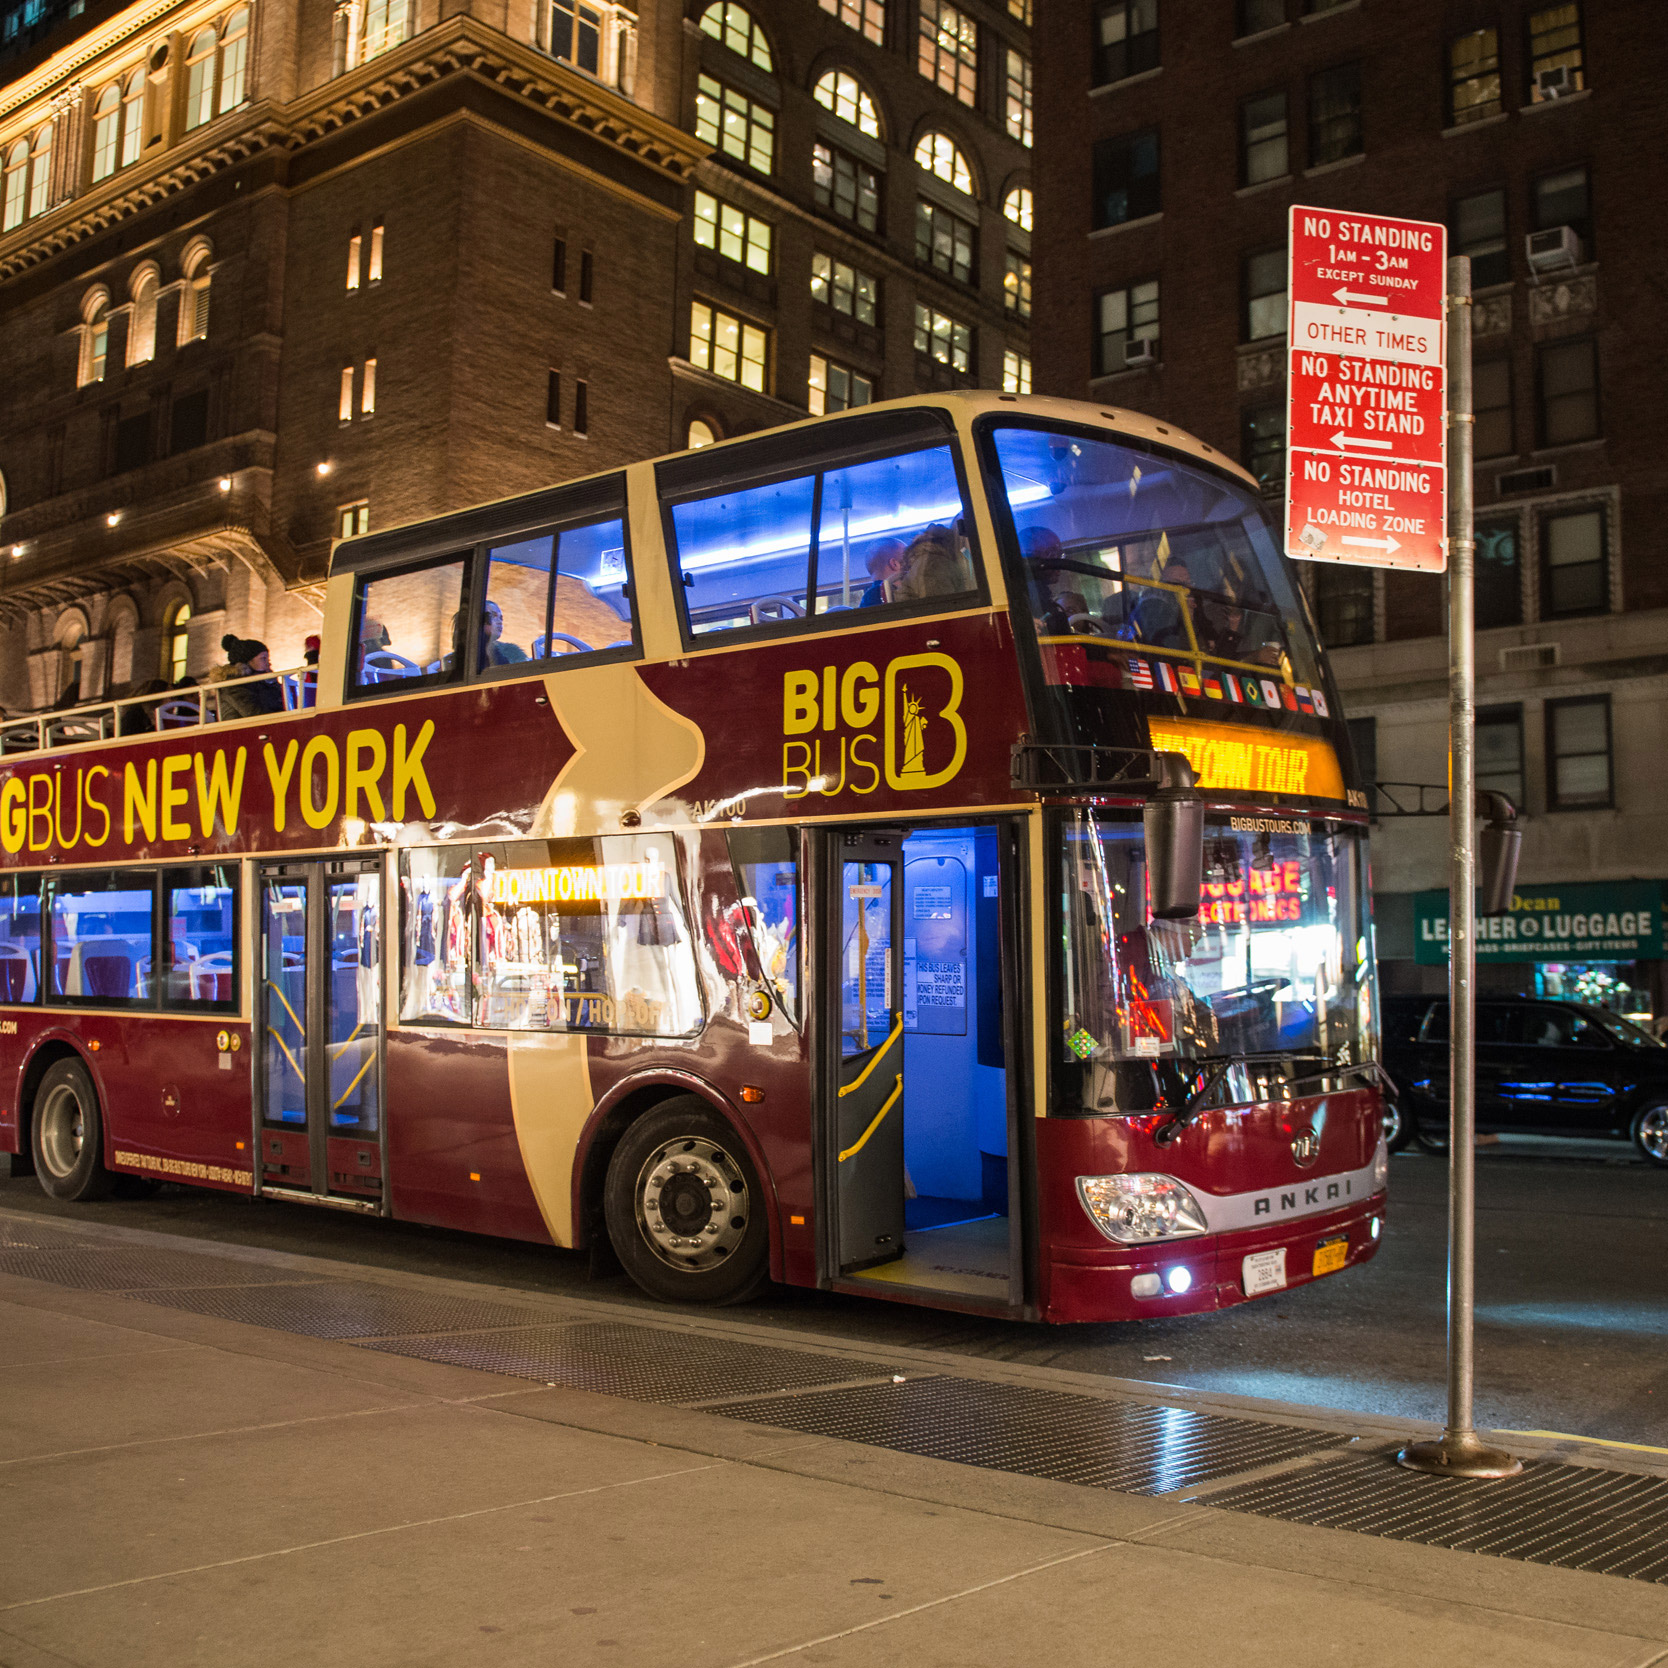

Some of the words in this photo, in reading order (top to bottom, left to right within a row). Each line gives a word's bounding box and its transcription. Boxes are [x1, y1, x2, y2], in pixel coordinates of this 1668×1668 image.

[1304, 216, 1331, 238] NO
[1338, 221, 1433, 252] STANDING
[1328, 244, 1357, 265] 1AM
[1374, 251, 1409, 271] 3AM
[1317, 267, 1365, 284] EXCEPT
[1368, 273, 1419, 291] SUNDAY
[1307, 322, 1367, 345] OTHER
[1376, 330, 1428, 353] TIMES
[1301, 356, 1328, 378] NO
[1338, 360, 1434, 391] STANDING
[1318, 382, 1418, 413] ANYTIME
[1310, 404, 1354, 428] TAXI
[1363, 410, 1425, 436] STAND
[1304, 460, 1331, 483] NO
[1339, 464, 1431, 495] STANDING
[1338, 490, 1395, 511] HOTEL
[1307, 506, 1377, 530] LOADING
[1382, 515, 1426, 535] ZONE
[783, 661, 880, 735] BIG
[783, 734, 880, 799] BUS
[1255, 744, 1309, 794] TOUR
[123, 746, 248, 846] NEW
[263, 719, 437, 834] YORK
[1230, 816, 1312, 836] BIGBUSTOURS.COM
[493, 866, 602, 902] DOWNTOWN
[606, 862, 662, 899] TOUR
[1508, 895, 1561, 912] Dean
[1421, 917, 1517, 941] LEHER
[1542, 911, 1652, 939] LUGGAGE
[928, 962, 940, 973] BUS
[940, 962, 961, 974] LEAVES
[934, 973, 953, 984] SHARP
[952, 974, 962, 985] OR
[935, 984, 964, 996] REFUNDED
[1254, 1179, 1351, 1215] ANKAI
